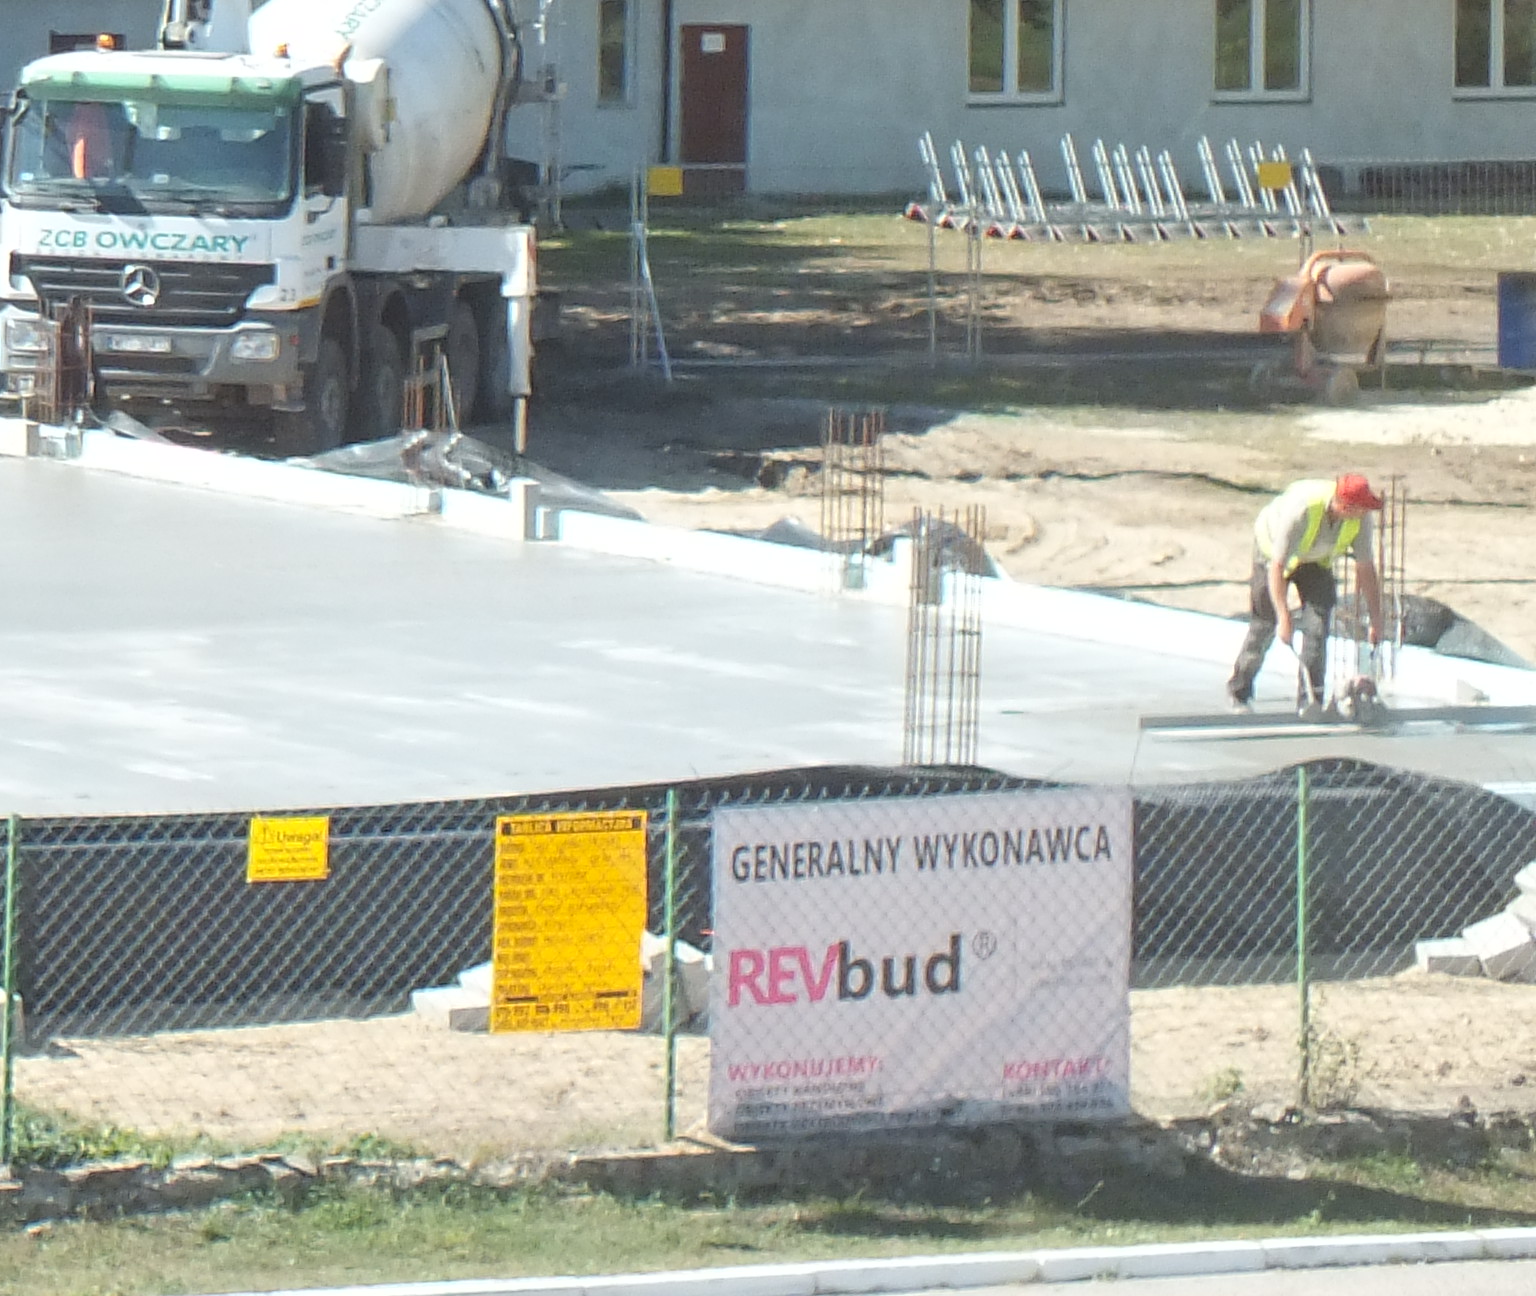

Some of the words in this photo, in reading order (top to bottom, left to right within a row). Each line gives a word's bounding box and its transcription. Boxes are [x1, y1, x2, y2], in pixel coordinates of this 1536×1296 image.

[38, 229, 87, 249] ZCB
[96, 230, 248, 253] OWCZARY
[731, 835, 903, 884] GENERALNY
[912, 824, 1113, 873] WYKONAWCA
